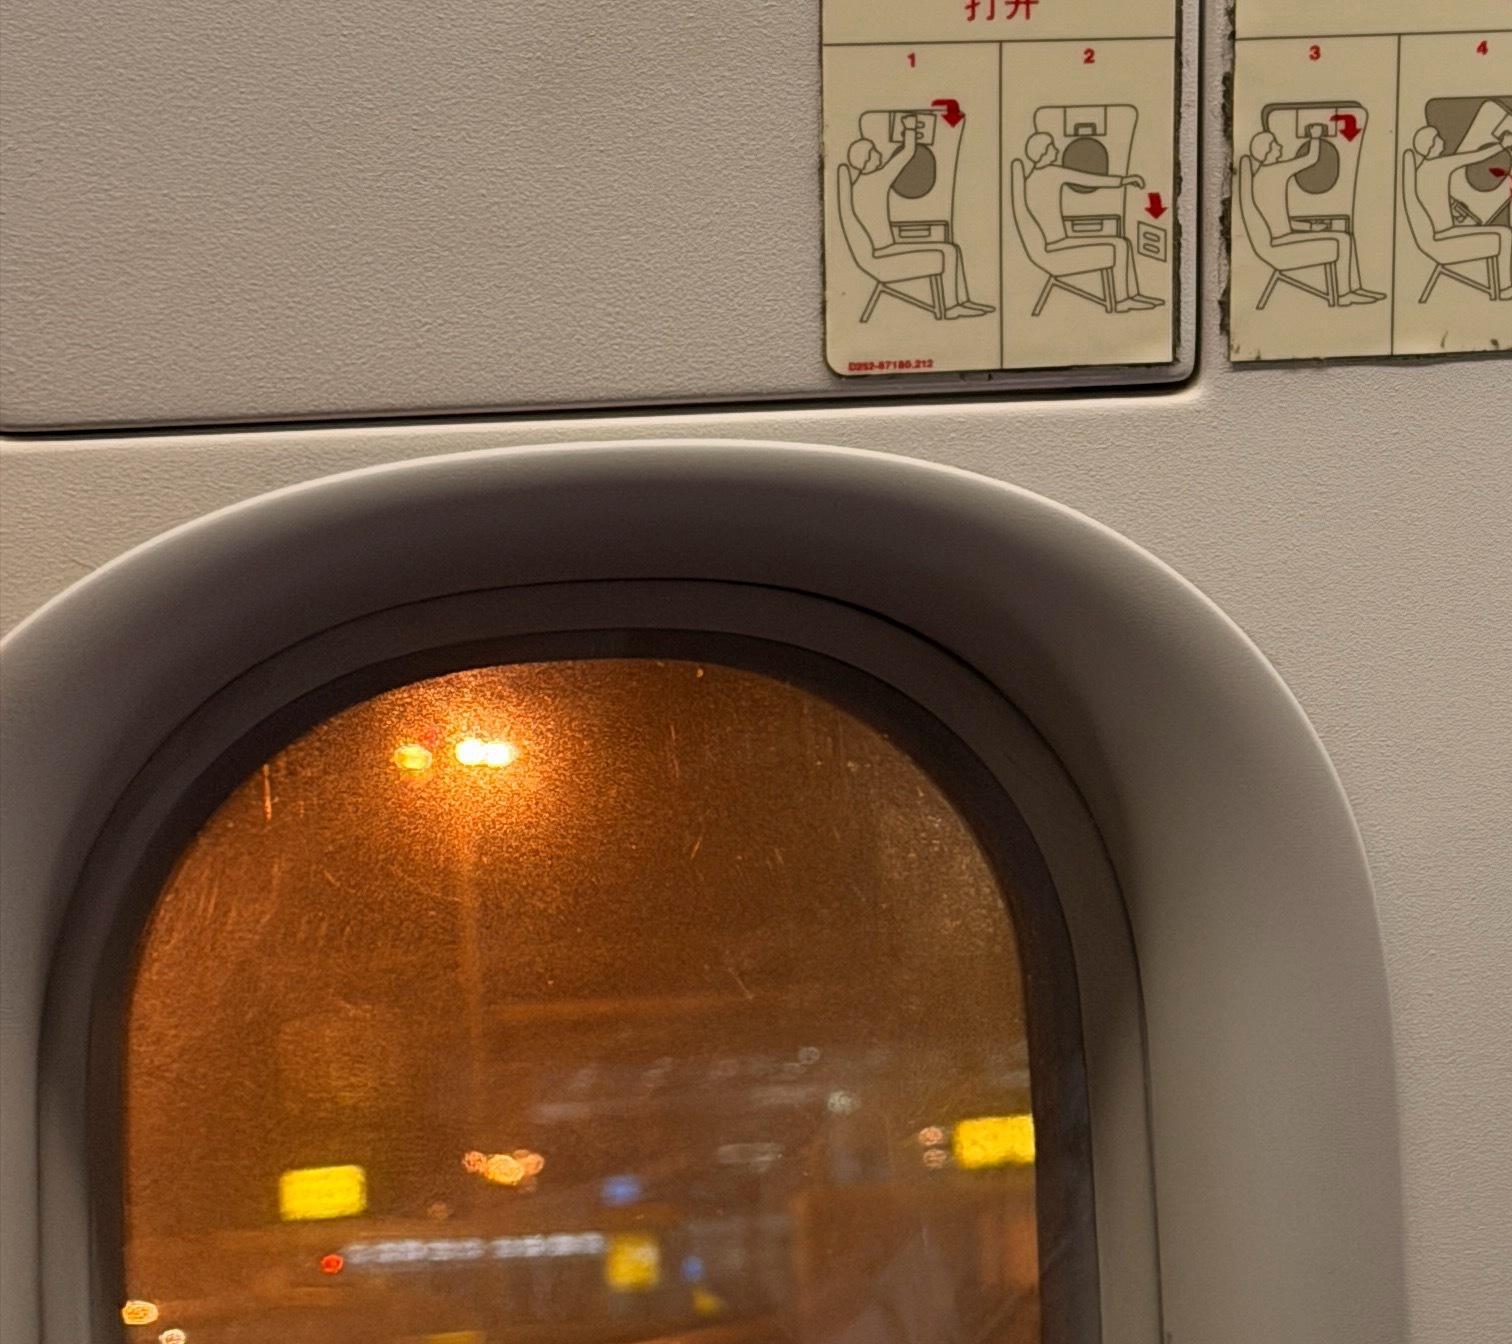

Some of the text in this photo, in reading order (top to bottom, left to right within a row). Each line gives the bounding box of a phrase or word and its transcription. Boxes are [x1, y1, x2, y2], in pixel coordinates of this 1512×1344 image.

[906, 47, 1096, 68] 1 2
[1308, 44, 1322, 61] 3
[1475, 39, 1489, 56] 4
